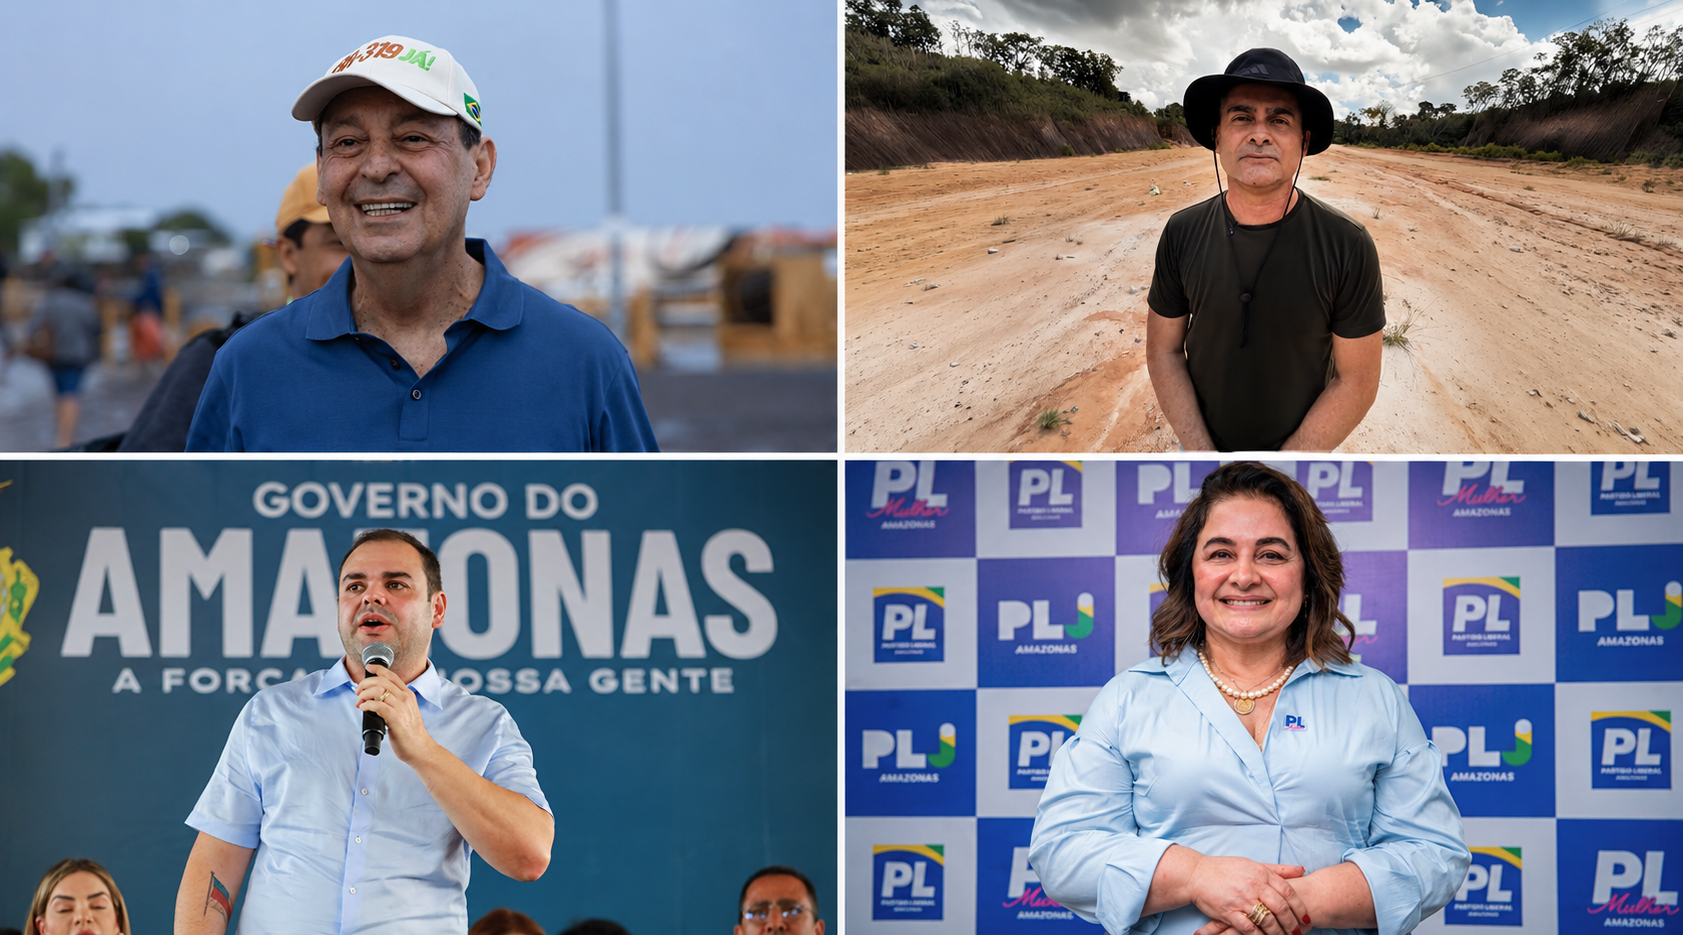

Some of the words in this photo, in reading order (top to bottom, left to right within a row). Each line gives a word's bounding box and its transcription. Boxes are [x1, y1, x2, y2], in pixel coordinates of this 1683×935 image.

[398, 48, 436, 71] JÁ!
[870, 461, 948, 509] PL
[1018, 468, 1073, 506] PL
[1138, 461, 1202, 505] PL
[1306, 462, 1363, 500] PL
[1442, 461, 1525, 496] PL
[1601, 461, 1660, 491] PL
[252, 481, 509, 520] GOVERNO
[525, 483, 599, 520] DO
[866, 496, 950, 518] Mulher
[1436, 483, 1526, 506] Mulher
[1452, 507, 1512, 517] AMAZONAS
[60, 527, 778, 660] AMAONAS
[882, 604, 937, 641] PL
[1452, 594, 1511, 632] PL
[1015, 644, 1077, 654] AMAZONAS
[1597, 635, 1664, 647] AMAZONAS
[112, 667, 142, 693] A
[439, 667, 572, 694] OSSA
[589, 667, 735, 694] GENTE
[1285, 714, 1306, 729] PL
[1601, 727, 1662, 766] PL
[879, 773, 939, 783] AMAZONAS
[1450, 772, 1515, 782] AMAZONAS
[881, 861, 936, 898] PL
[1454, 864, 1513, 902] PL
[1592, 849, 1679, 906] PL
[1586, 892, 1680, 915] Mulher
[1603, 918, 1665, 928] AMAZONAS
